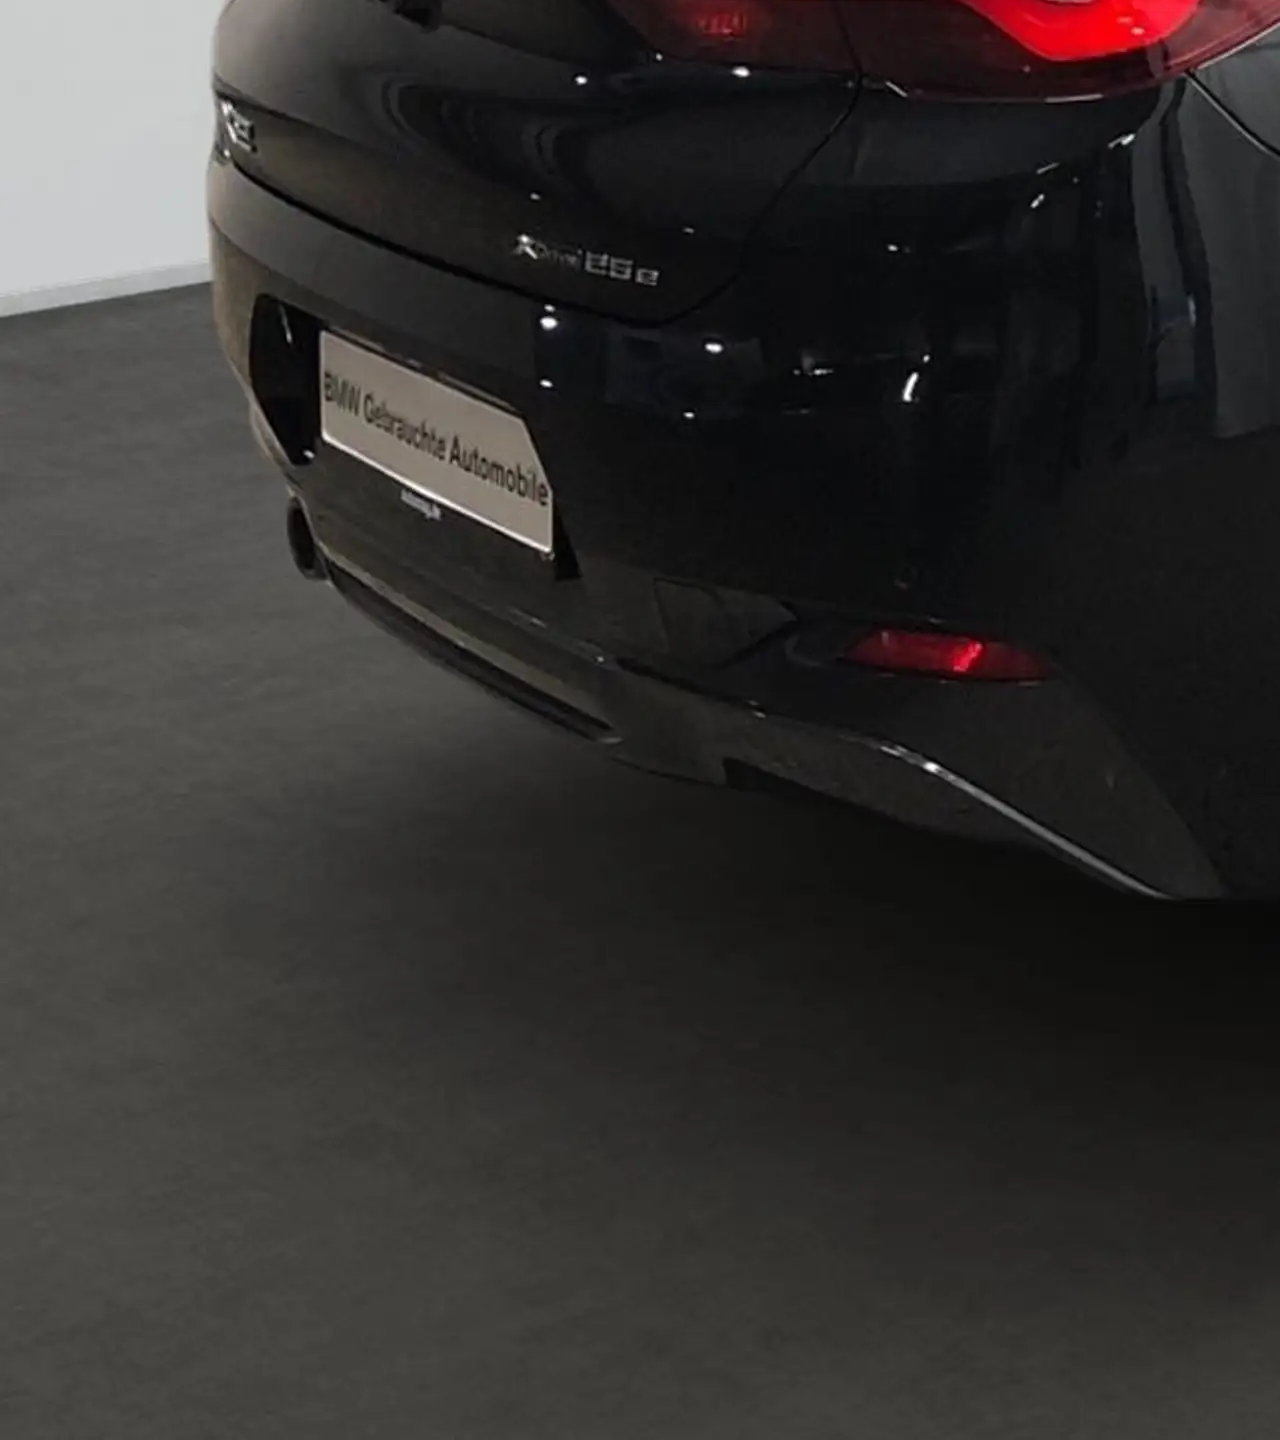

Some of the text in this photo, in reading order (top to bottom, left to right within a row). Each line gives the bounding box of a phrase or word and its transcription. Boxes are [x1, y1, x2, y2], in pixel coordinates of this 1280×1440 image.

[323, 370, 362, 418] BMW
[362, 392, 447, 461] Gebrauchte
[448, 434, 549, 507] Automobile
